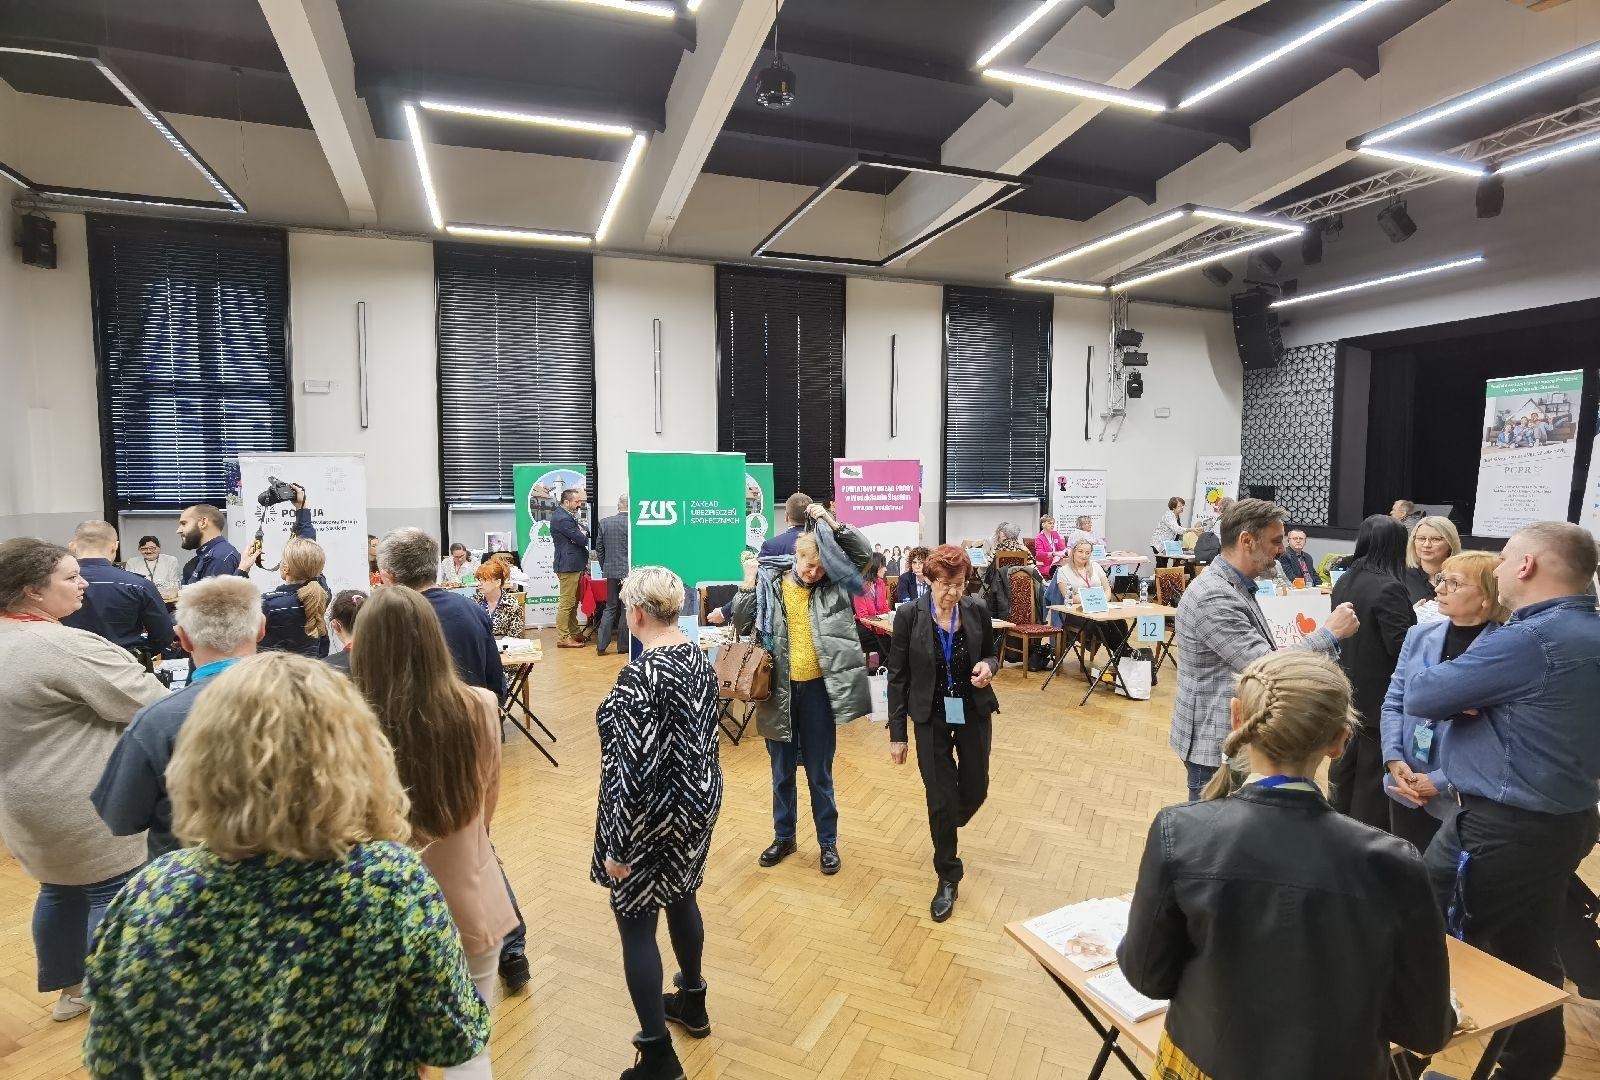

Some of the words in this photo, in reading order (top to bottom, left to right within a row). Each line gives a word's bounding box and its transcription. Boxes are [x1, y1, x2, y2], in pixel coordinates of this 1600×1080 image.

[281, 508, 324, 518] POJA
[636, 500, 678, 526] ZUS
[1142, 622, 1158, 637] 12
